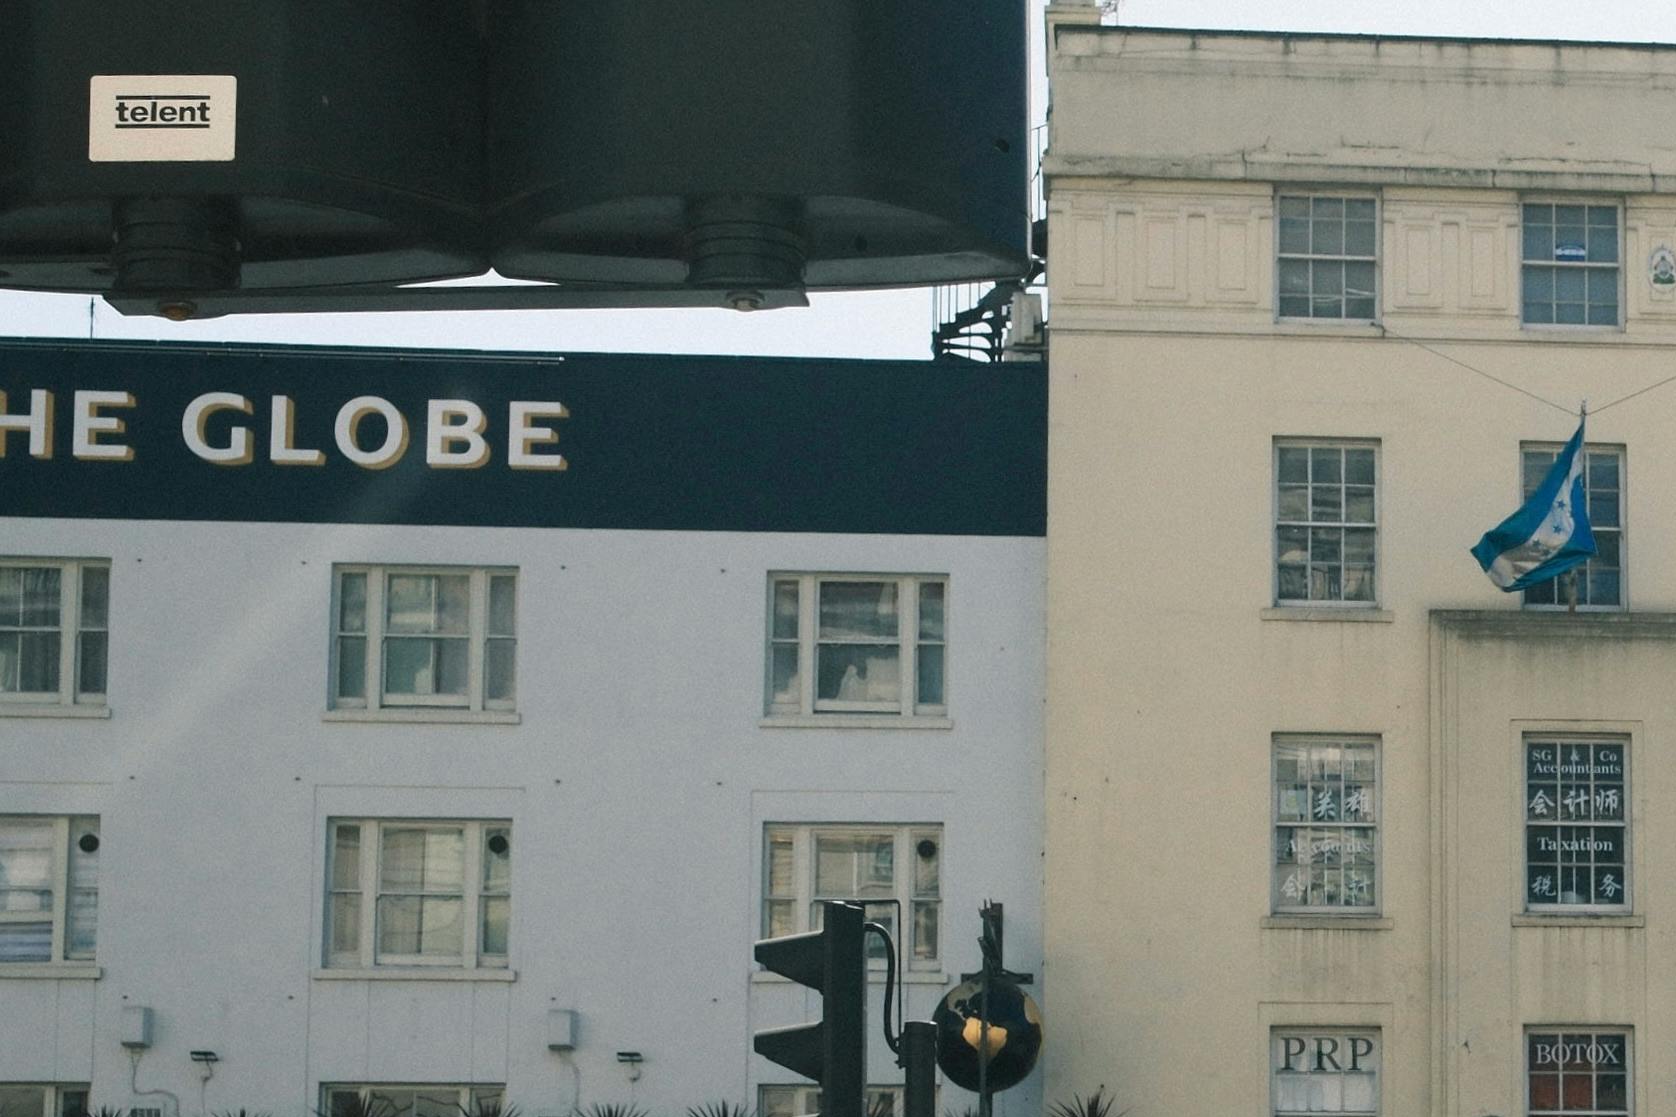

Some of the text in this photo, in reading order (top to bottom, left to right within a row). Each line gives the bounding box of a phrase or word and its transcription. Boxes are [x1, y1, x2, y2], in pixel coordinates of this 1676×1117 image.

[115, 101, 211, 122] telent
[182, 391, 570, 470] GLOBE
[1532, 750, 1552, 762] SG
[1599, 751, 1617, 762] Co
[1533, 763, 1622, 775] Accountants
[1529, 788, 1619, 817] 会计师
[1537, 837, 1614, 851] Taxation
[1280, 1036, 1374, 1071] PRP
[1535, 1043, 1621, 1065] BOTOX
